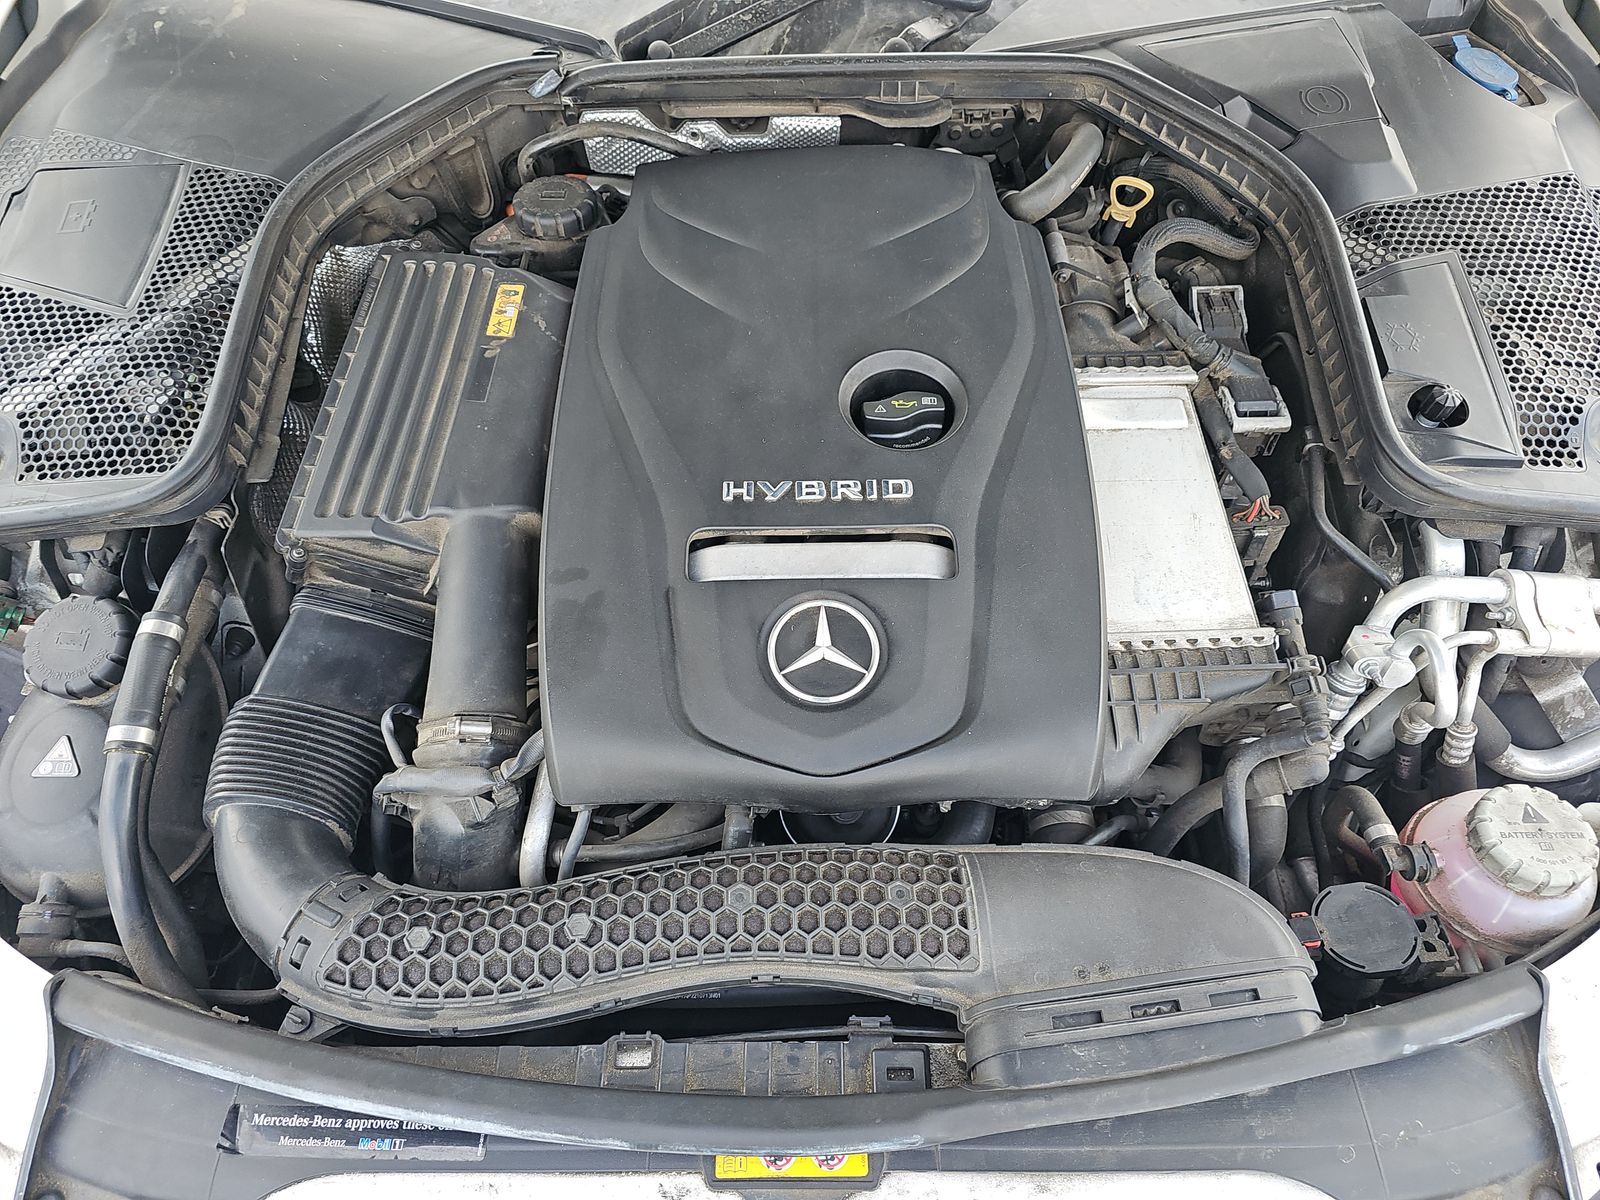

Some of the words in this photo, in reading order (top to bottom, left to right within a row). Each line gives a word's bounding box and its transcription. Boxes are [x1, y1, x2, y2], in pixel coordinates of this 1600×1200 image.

[722, 479, 914, 502] HYBRID
[1499, 831, 1544, 840] BATTERY
[1545, 831, 1586, 840] SYSTEM
[250, 1113, 343, 1129] Mercedes-Benz
[344, 1119, 400, 1131] approves
[278, 1135, 347, 1148] Mercedes-Benz
[357, 1137, 391, 1151] Mobil
